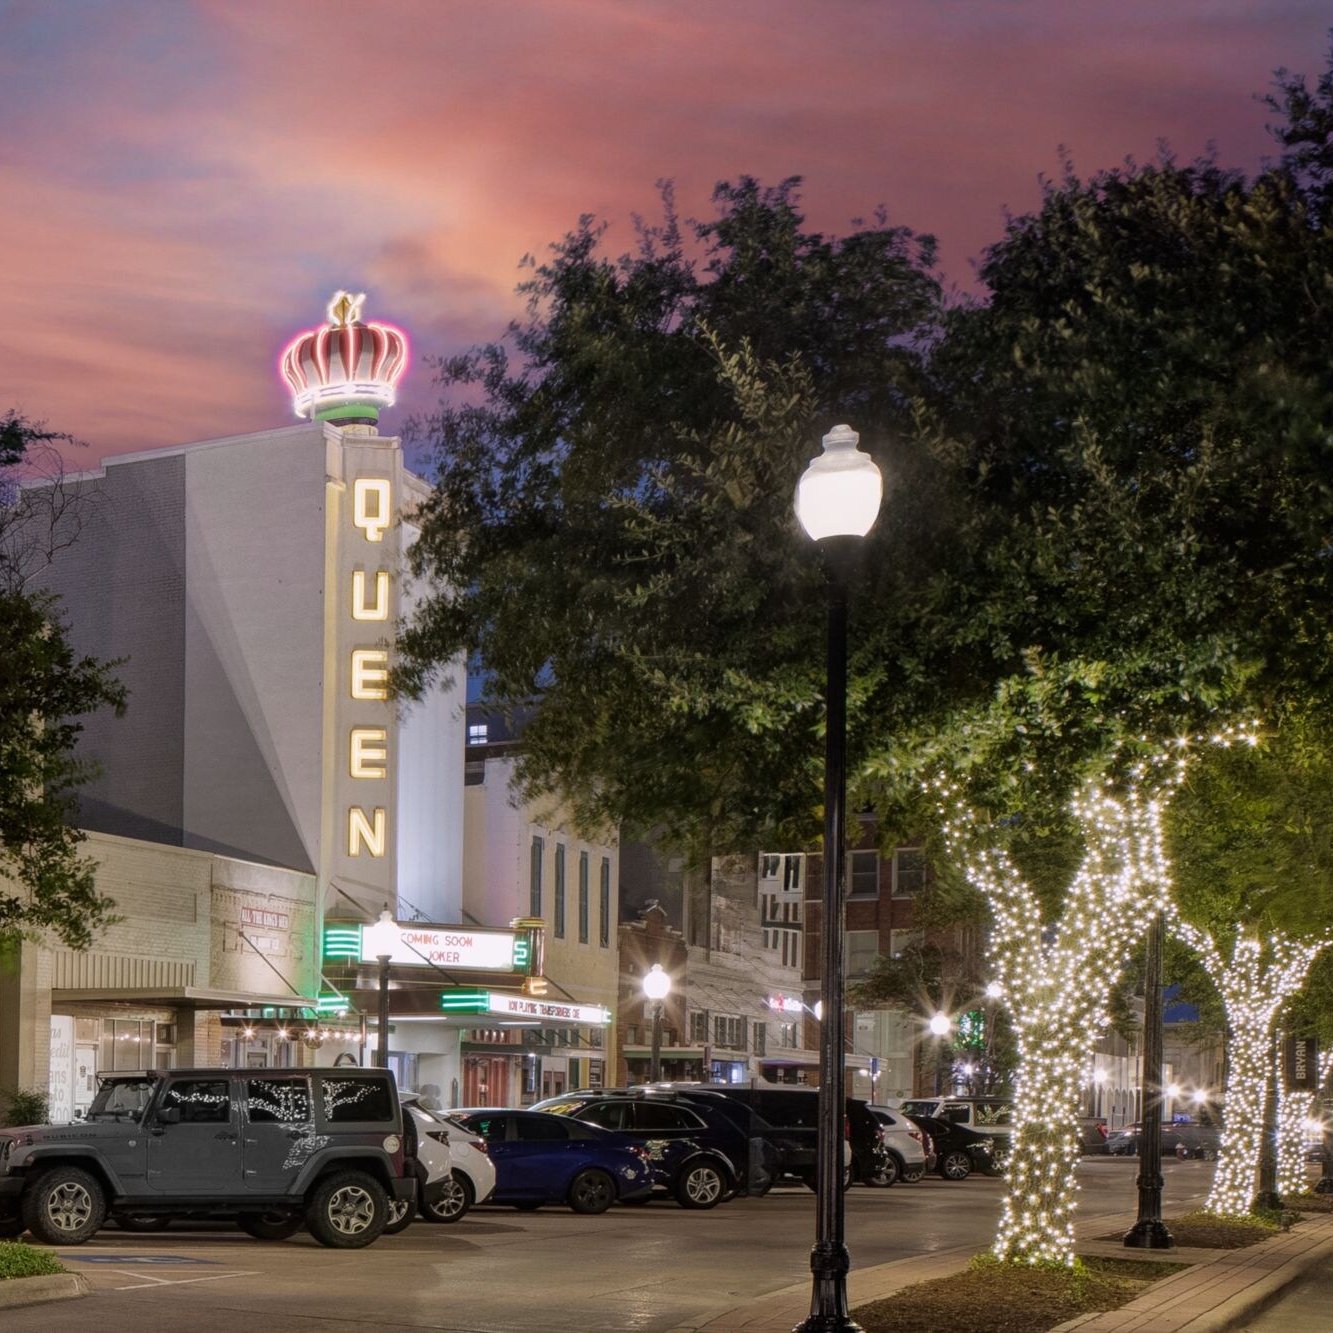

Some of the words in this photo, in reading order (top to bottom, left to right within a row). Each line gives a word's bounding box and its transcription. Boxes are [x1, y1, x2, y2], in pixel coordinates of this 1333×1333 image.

[347, 478, 391, 858] QUEEN
[400, 932, 439, 946] COMING
[445, 935, 473, 947] SOON
[428, 950, 460, 963] JOKER
[1295, 1040, 1307, 1080] BRYAN
